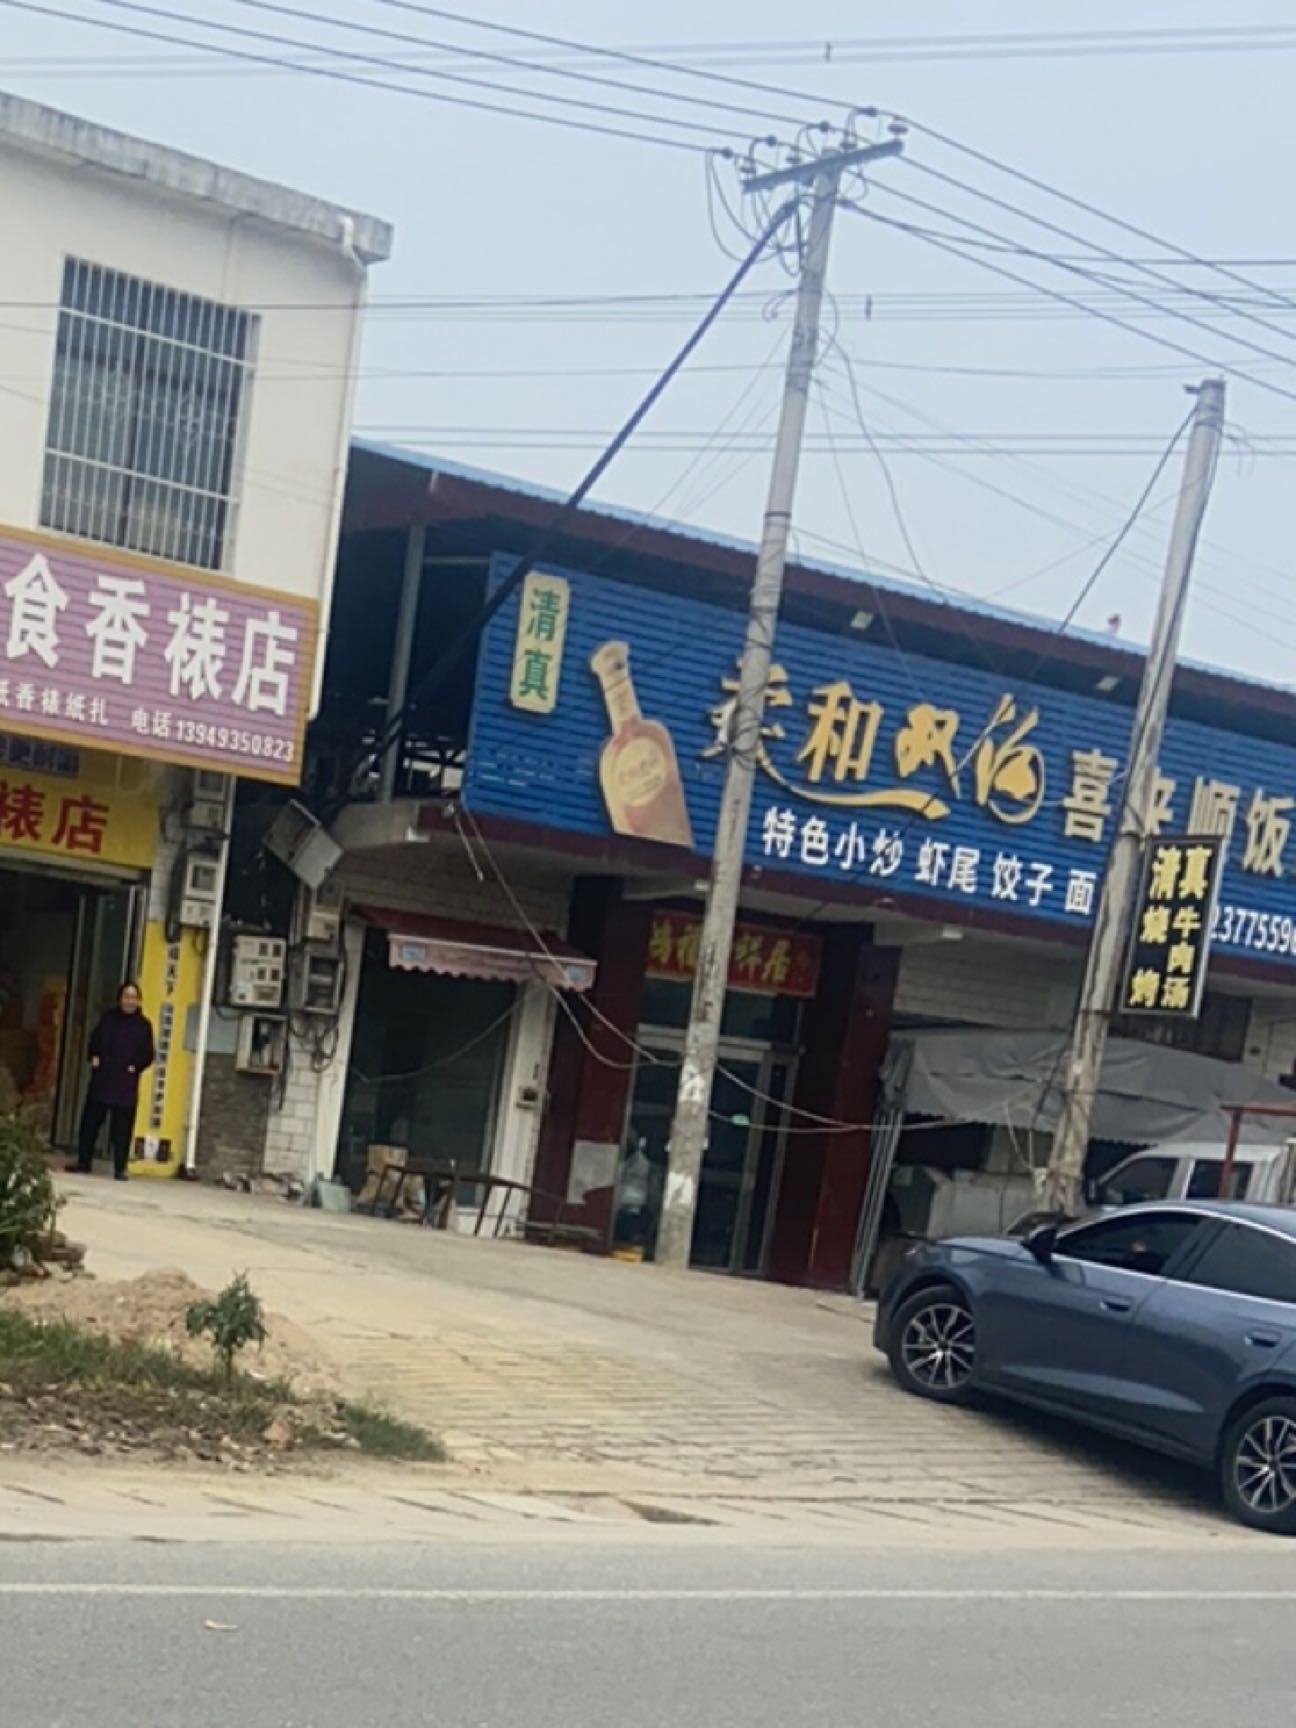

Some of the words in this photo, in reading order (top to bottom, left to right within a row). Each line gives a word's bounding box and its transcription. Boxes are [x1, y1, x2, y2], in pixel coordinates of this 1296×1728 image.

[517, 588, 561, 701] 清真
[762, 805, 903, 877] 特色小炒
